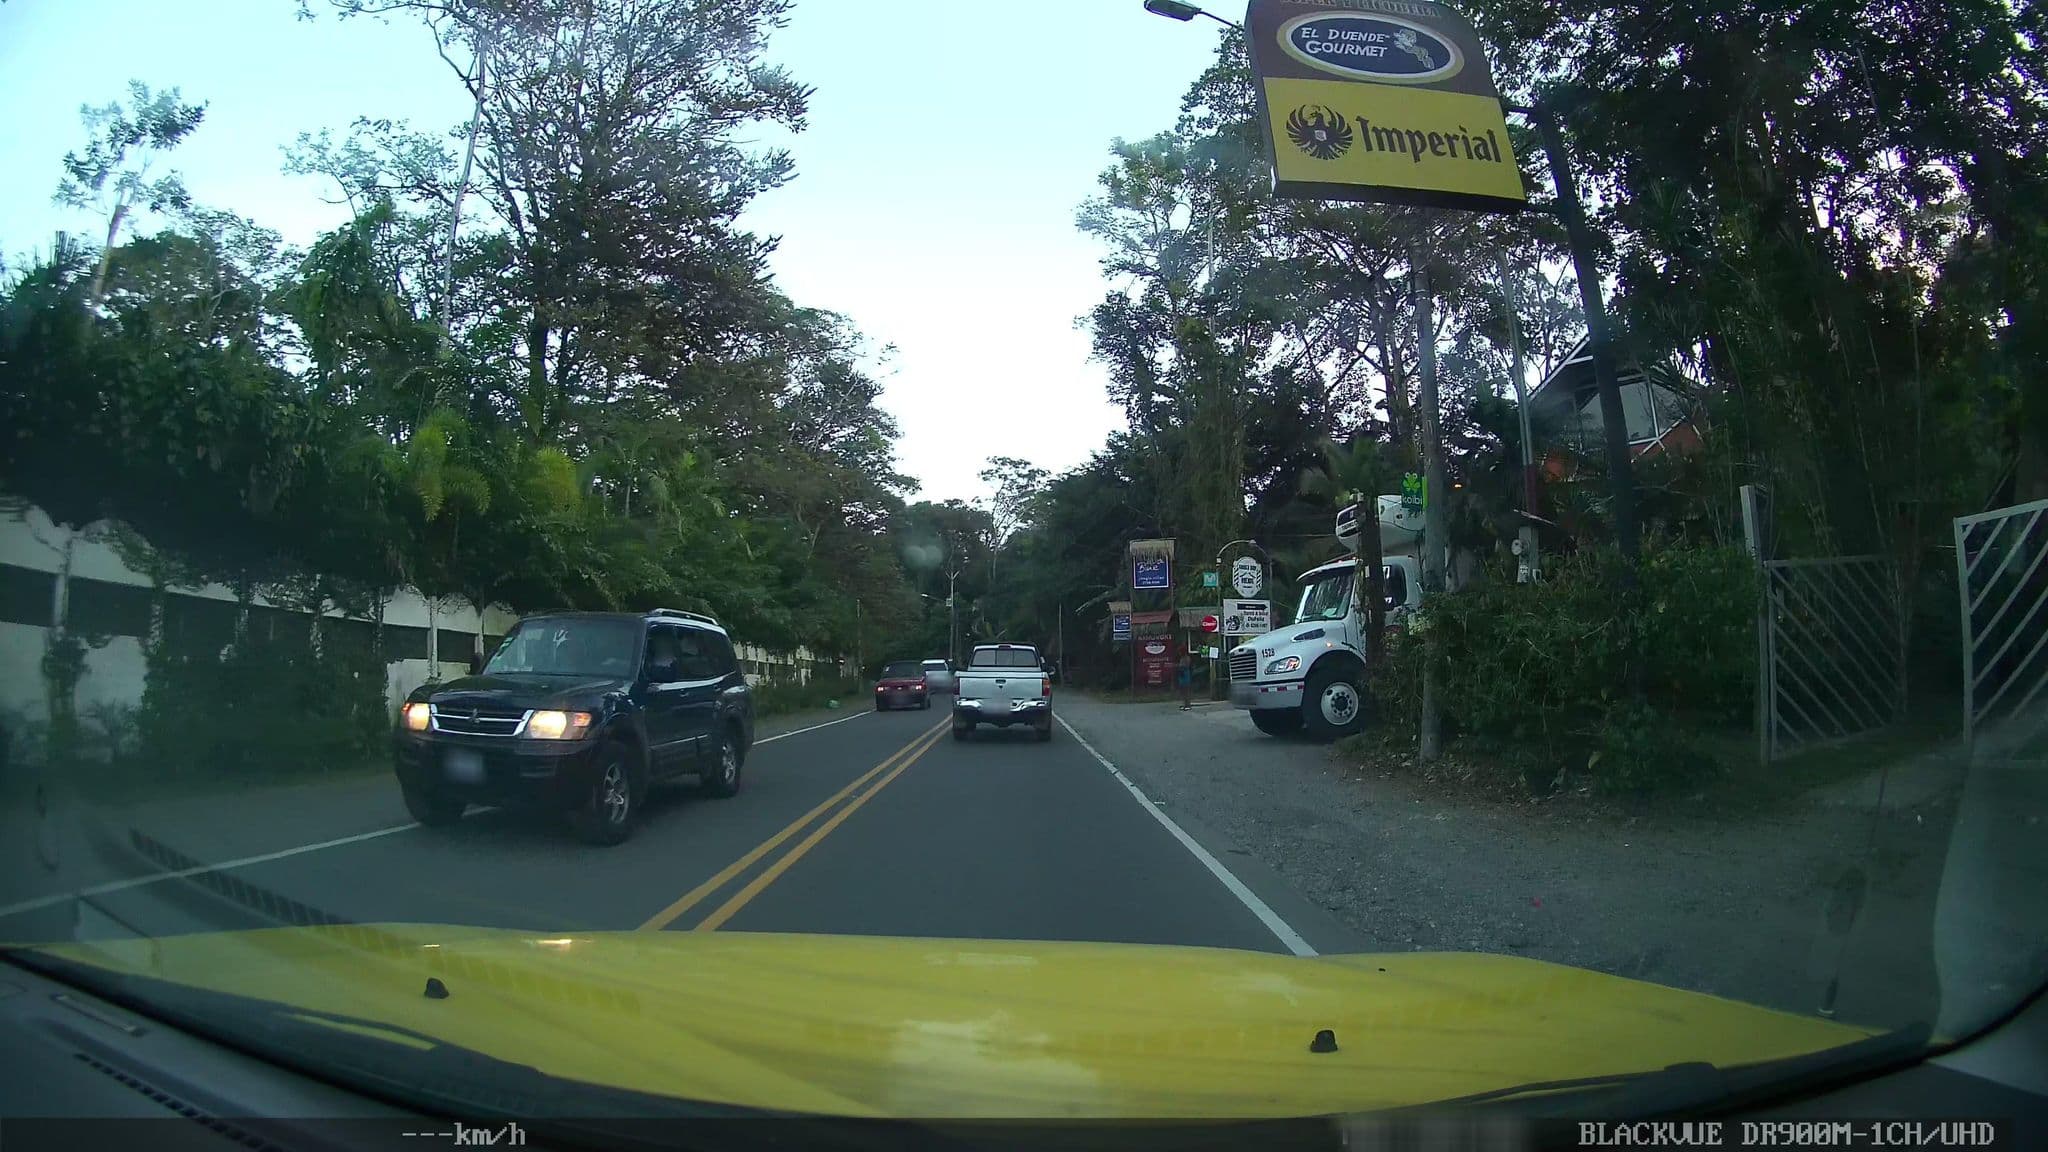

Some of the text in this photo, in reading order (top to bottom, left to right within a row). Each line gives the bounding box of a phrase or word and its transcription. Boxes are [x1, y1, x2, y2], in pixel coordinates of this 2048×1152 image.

[1301, 27, 1388, 43] EL DUENDE
[1305, 40, 1388, 57] GOURMET
[1355, 115, 1502, 163] Imperial
